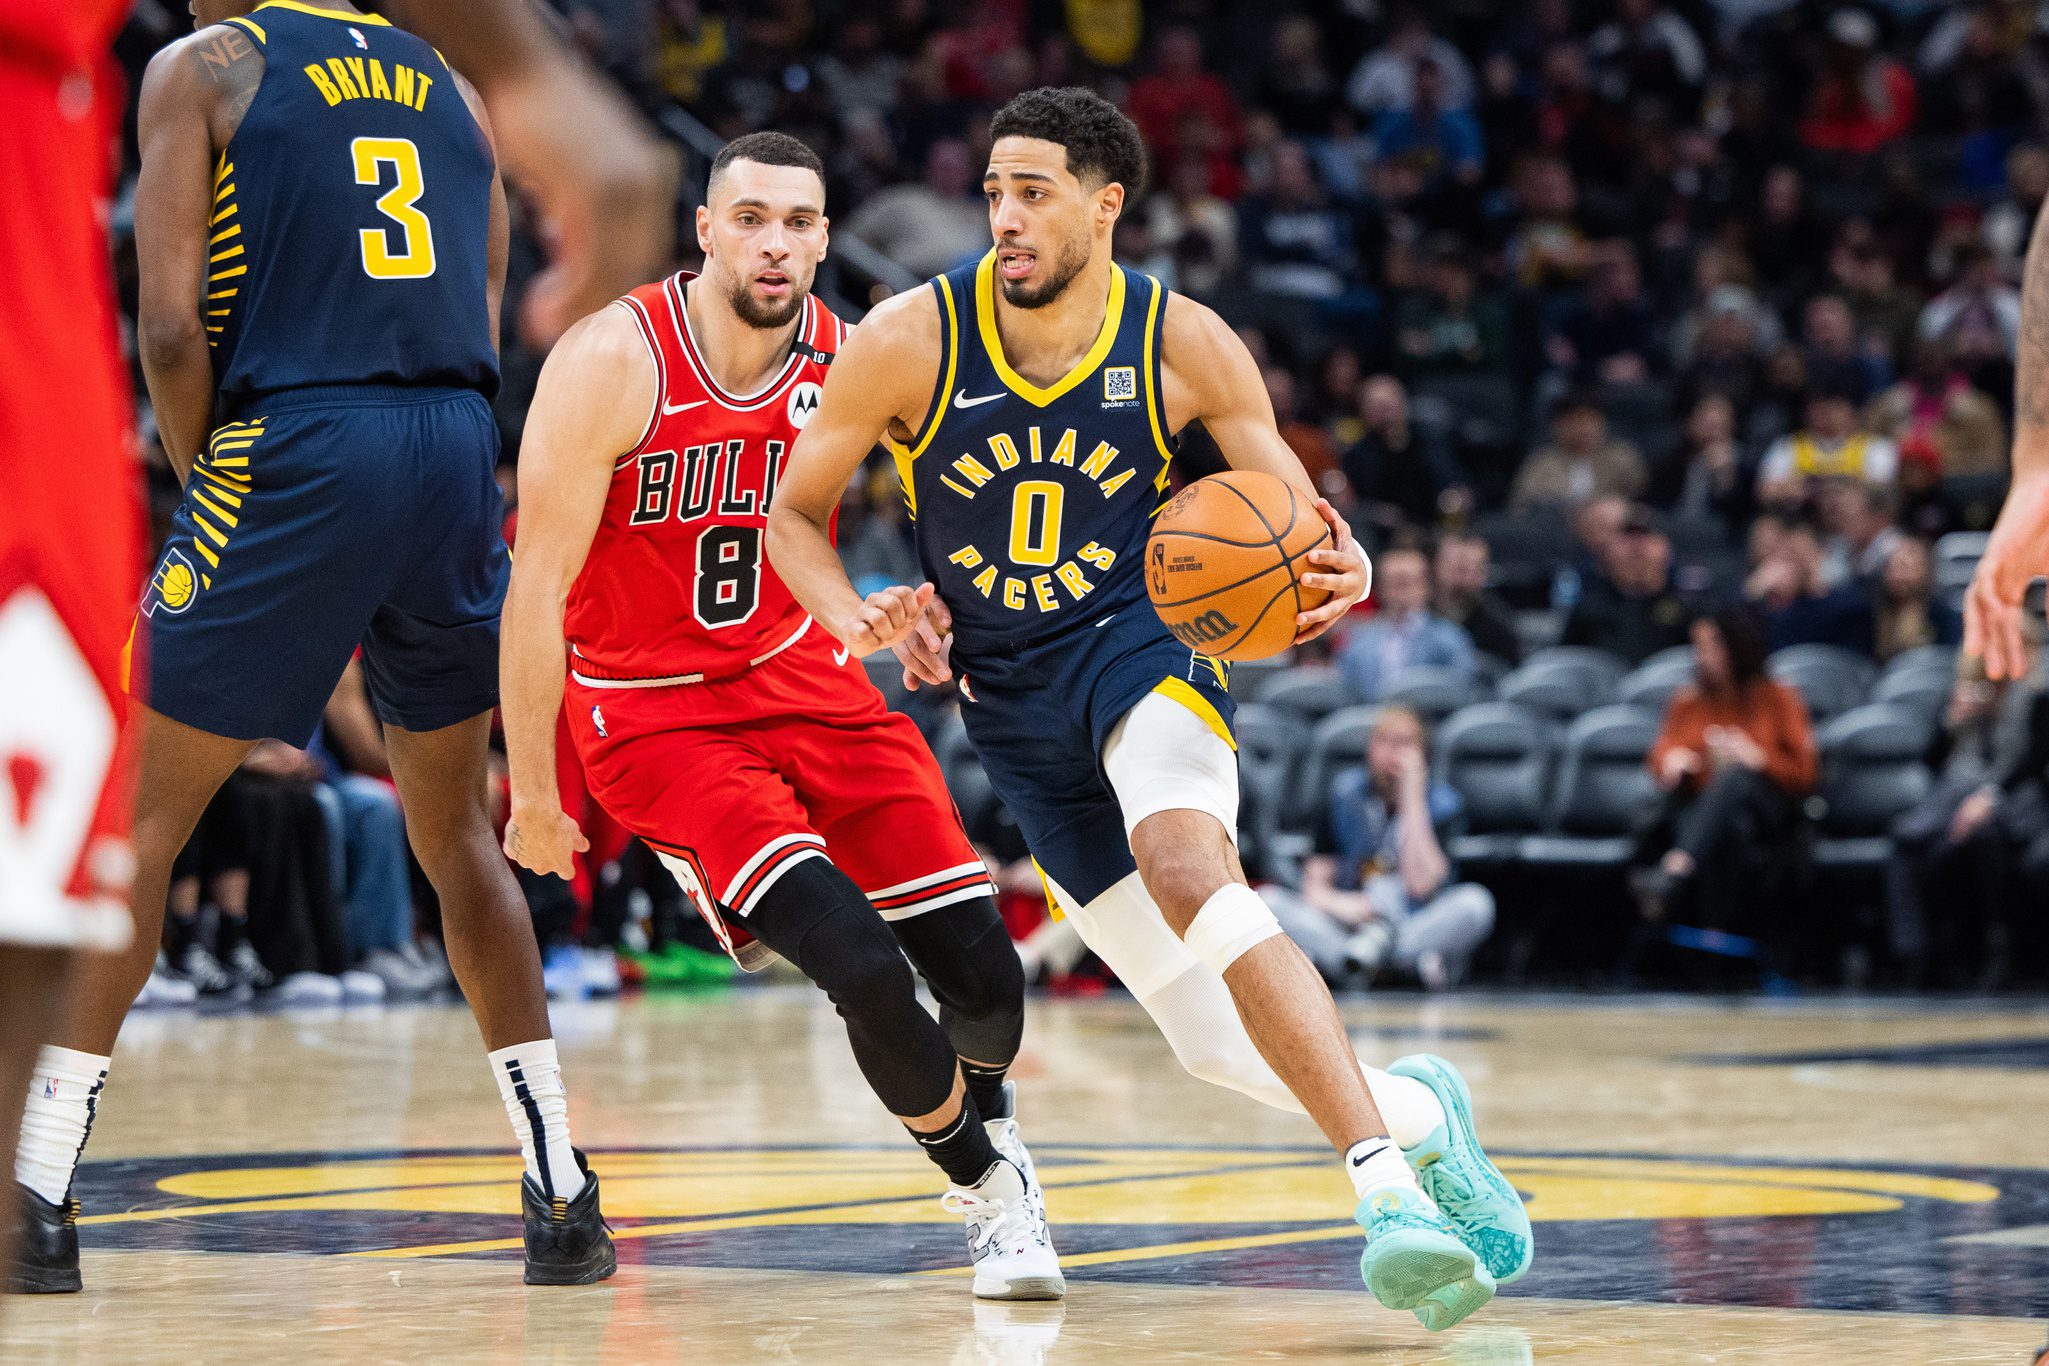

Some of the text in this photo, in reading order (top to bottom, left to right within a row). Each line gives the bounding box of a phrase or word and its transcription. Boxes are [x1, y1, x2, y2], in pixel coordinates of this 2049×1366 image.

[303, 56, 433, 112] BRYANT
[350, 136, 437, 280] 3
[812, 351, 826, 364] 10
[1101, 399, 1141, 410] spokenote
[629, 439, 785, 526] BULL
[939, 426, 1137, 500] INDIANA
[1008, 480, 1065, 567] 0
[693, 525, 762, 630] 8
[948, 540, 1117, 613] PACERS
